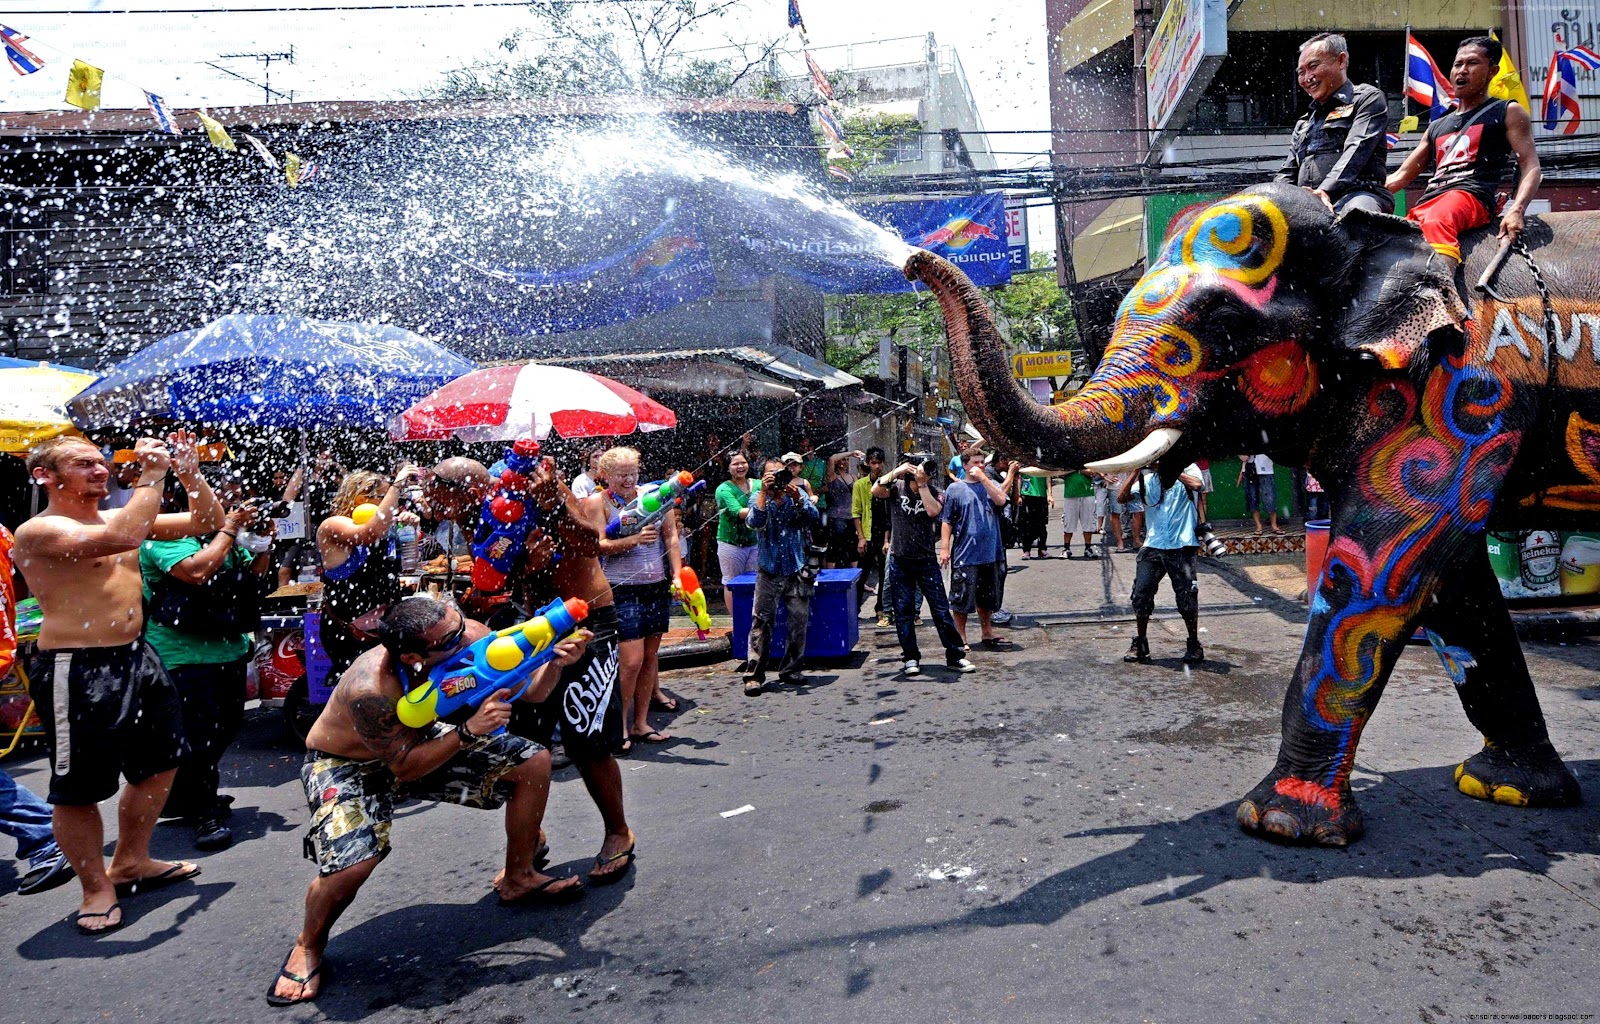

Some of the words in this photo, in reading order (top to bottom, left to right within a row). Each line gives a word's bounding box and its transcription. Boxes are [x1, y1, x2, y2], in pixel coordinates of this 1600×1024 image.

[1026, 355, 1054, 366] MOM
[1521, 546, 1560, 561] Heineken
[455, 677, 476, 693] 1500
